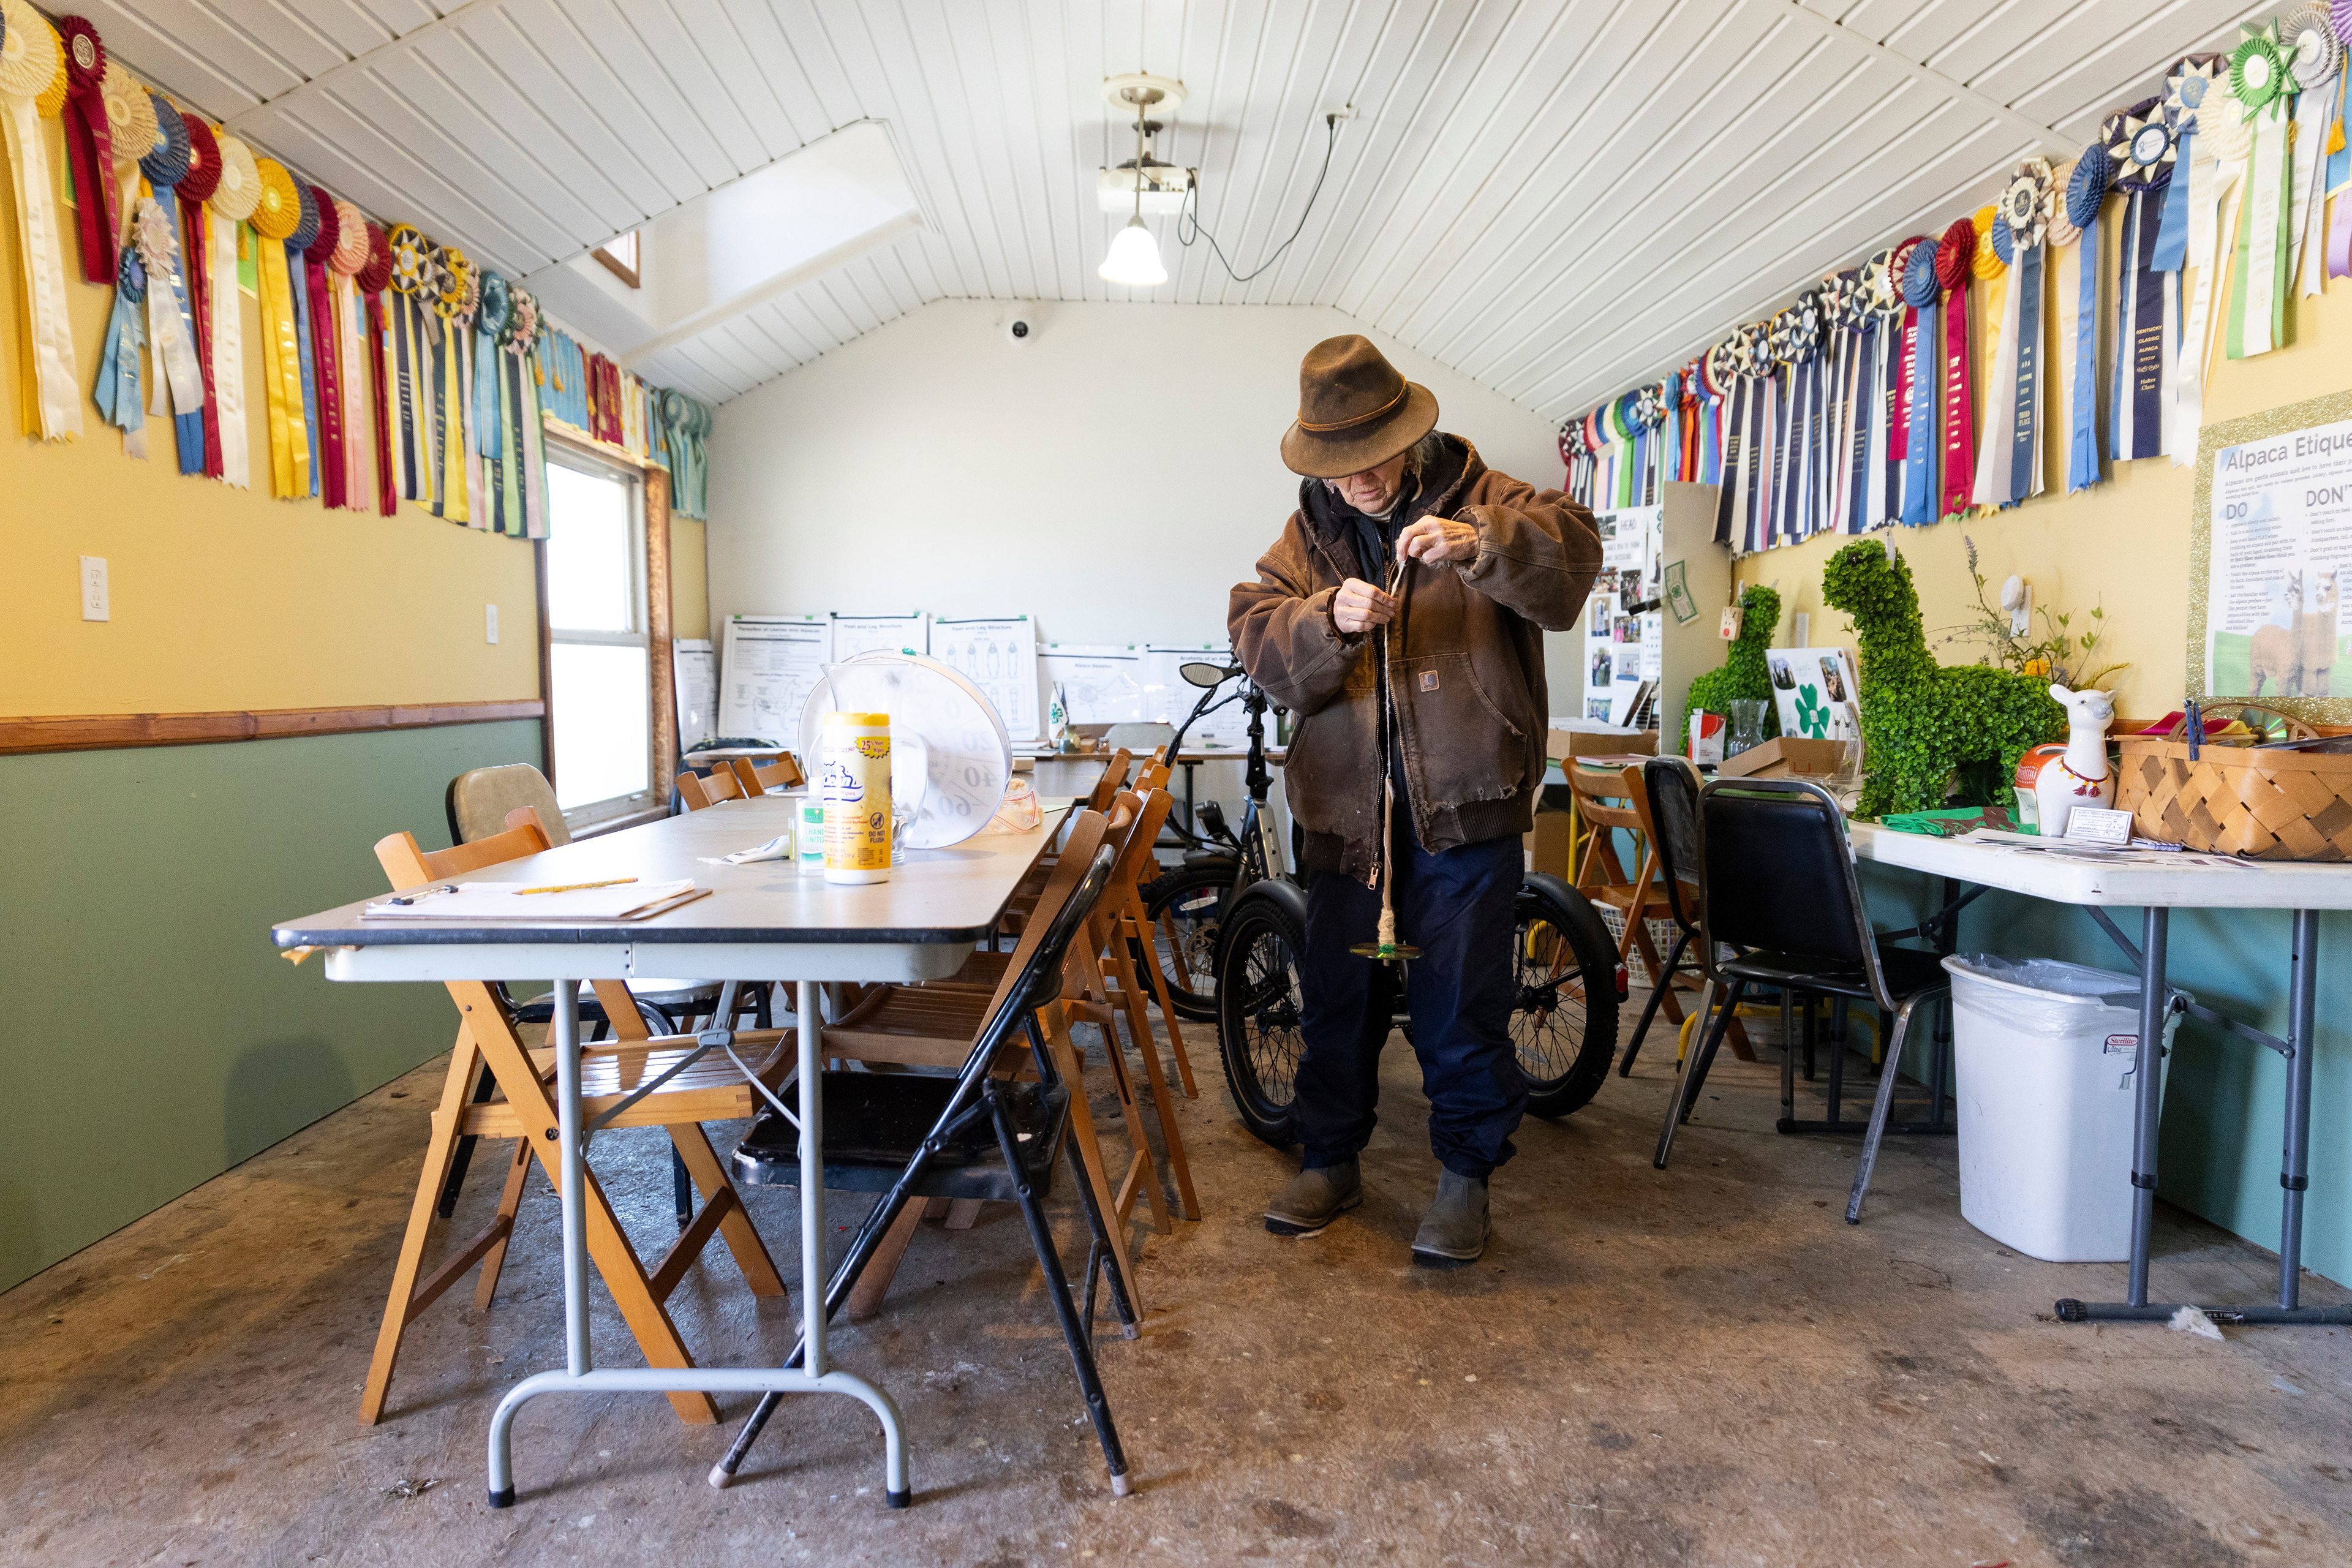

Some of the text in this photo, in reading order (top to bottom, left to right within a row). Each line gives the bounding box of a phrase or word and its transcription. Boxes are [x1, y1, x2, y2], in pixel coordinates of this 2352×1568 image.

[2136, 325, 2163, 334] KENTUCKY
[2138, 335, 2160, 344] CLASSIC
[2138, 345, 2159, 353] ALPACA
[2022, 360, 2030, 368] AOA
[2019, 410, 2030, 419] THIRD
[2019, 417, 2030, 427] PLACE
[2226, 445, 2288, 473] Alpaca
[2225, 478, 2244, 487] Alpacas
[2255, 473, 2269, 482] gentle
[2269, 469, 2288, 478] animals
[2306, 484, 2352, 508] DON'
[2226, 502, 2248, 520] DO
[1620, 518, 1637, 532] HEAD
[2330, 551, 2350, 560] frightens
